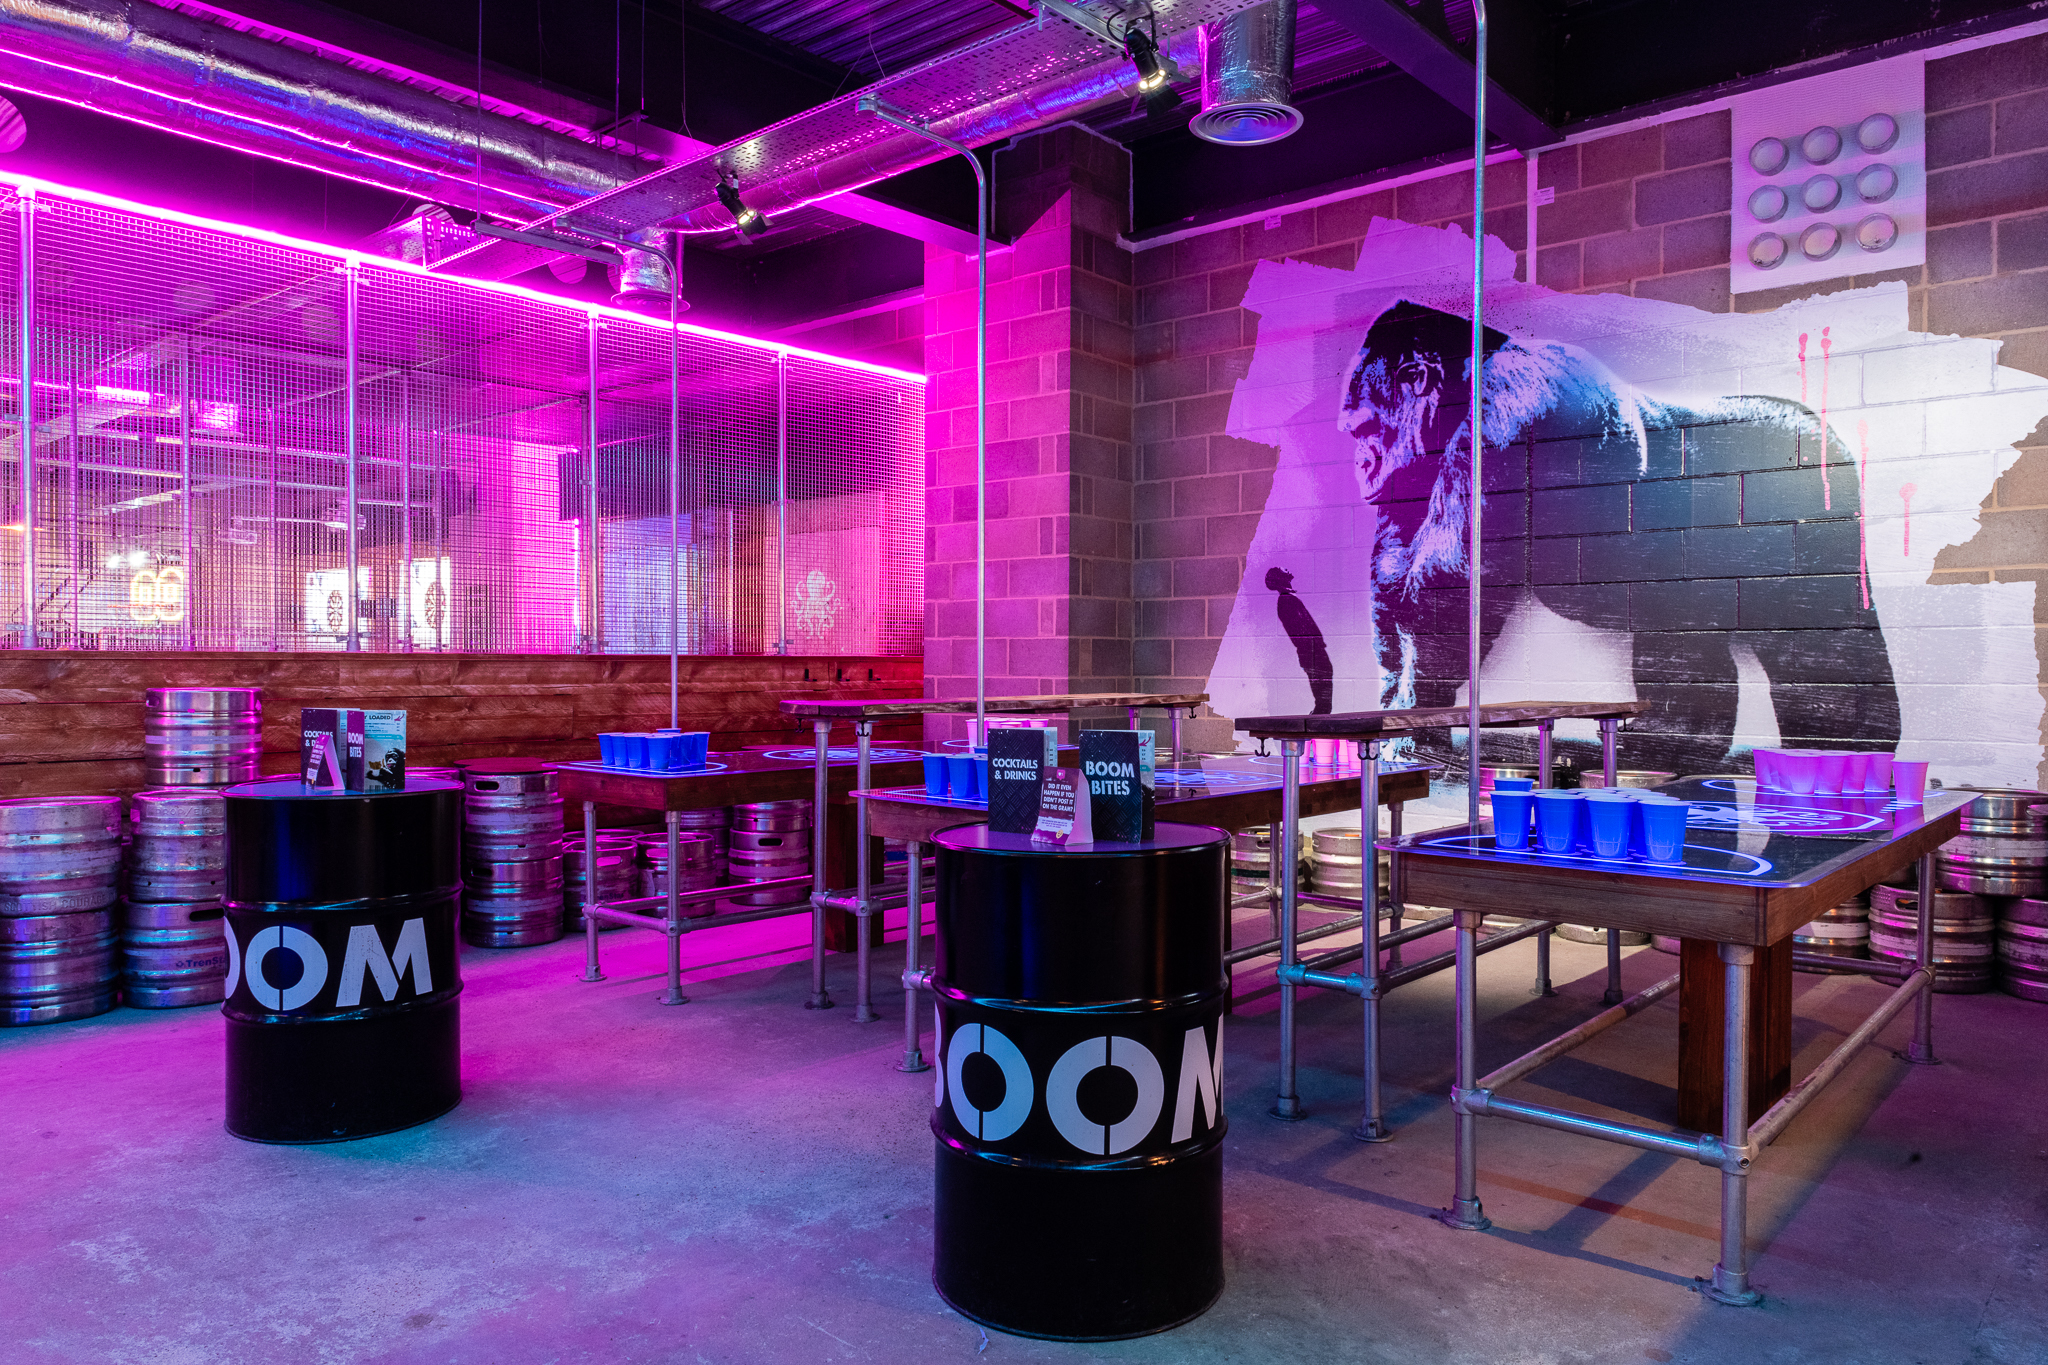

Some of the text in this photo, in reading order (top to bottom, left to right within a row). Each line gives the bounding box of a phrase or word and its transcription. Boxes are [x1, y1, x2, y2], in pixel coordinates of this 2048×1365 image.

[348, 732, 364, 745] BOOM
[350, 746, 362, 757] BITES
[992, 758, 1039, 769] COCKTAILS
[1085, 760, 1135, 778] BOOM
[994, 770, 1037, 780] & DRINKS
[1091, 780, 1131, 796] BITES
[186, 956, 225, 968] TrenSt
